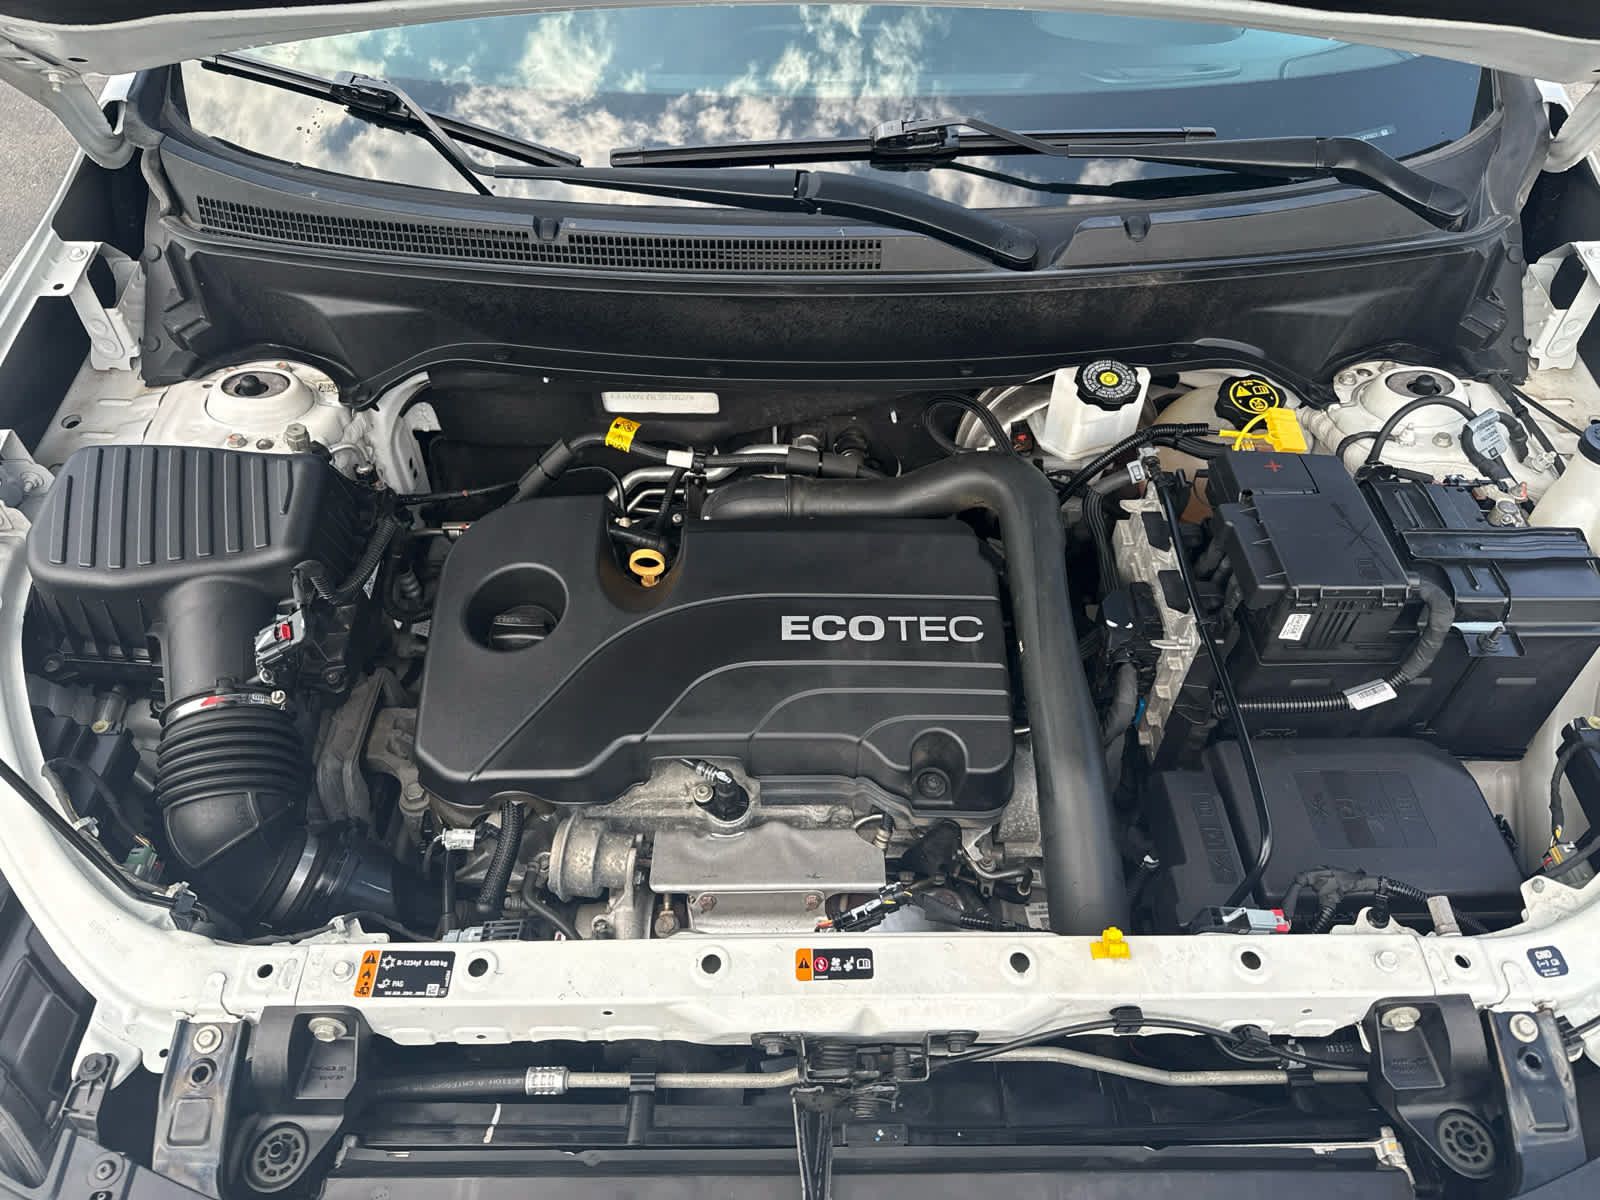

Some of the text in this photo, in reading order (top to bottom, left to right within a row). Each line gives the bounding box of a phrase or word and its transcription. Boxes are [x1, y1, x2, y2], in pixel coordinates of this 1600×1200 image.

[781, 615, 984, 642] ECOTEC
[1535, 950, 1552, 960] GND
[440, 960, 448, 968] kg
